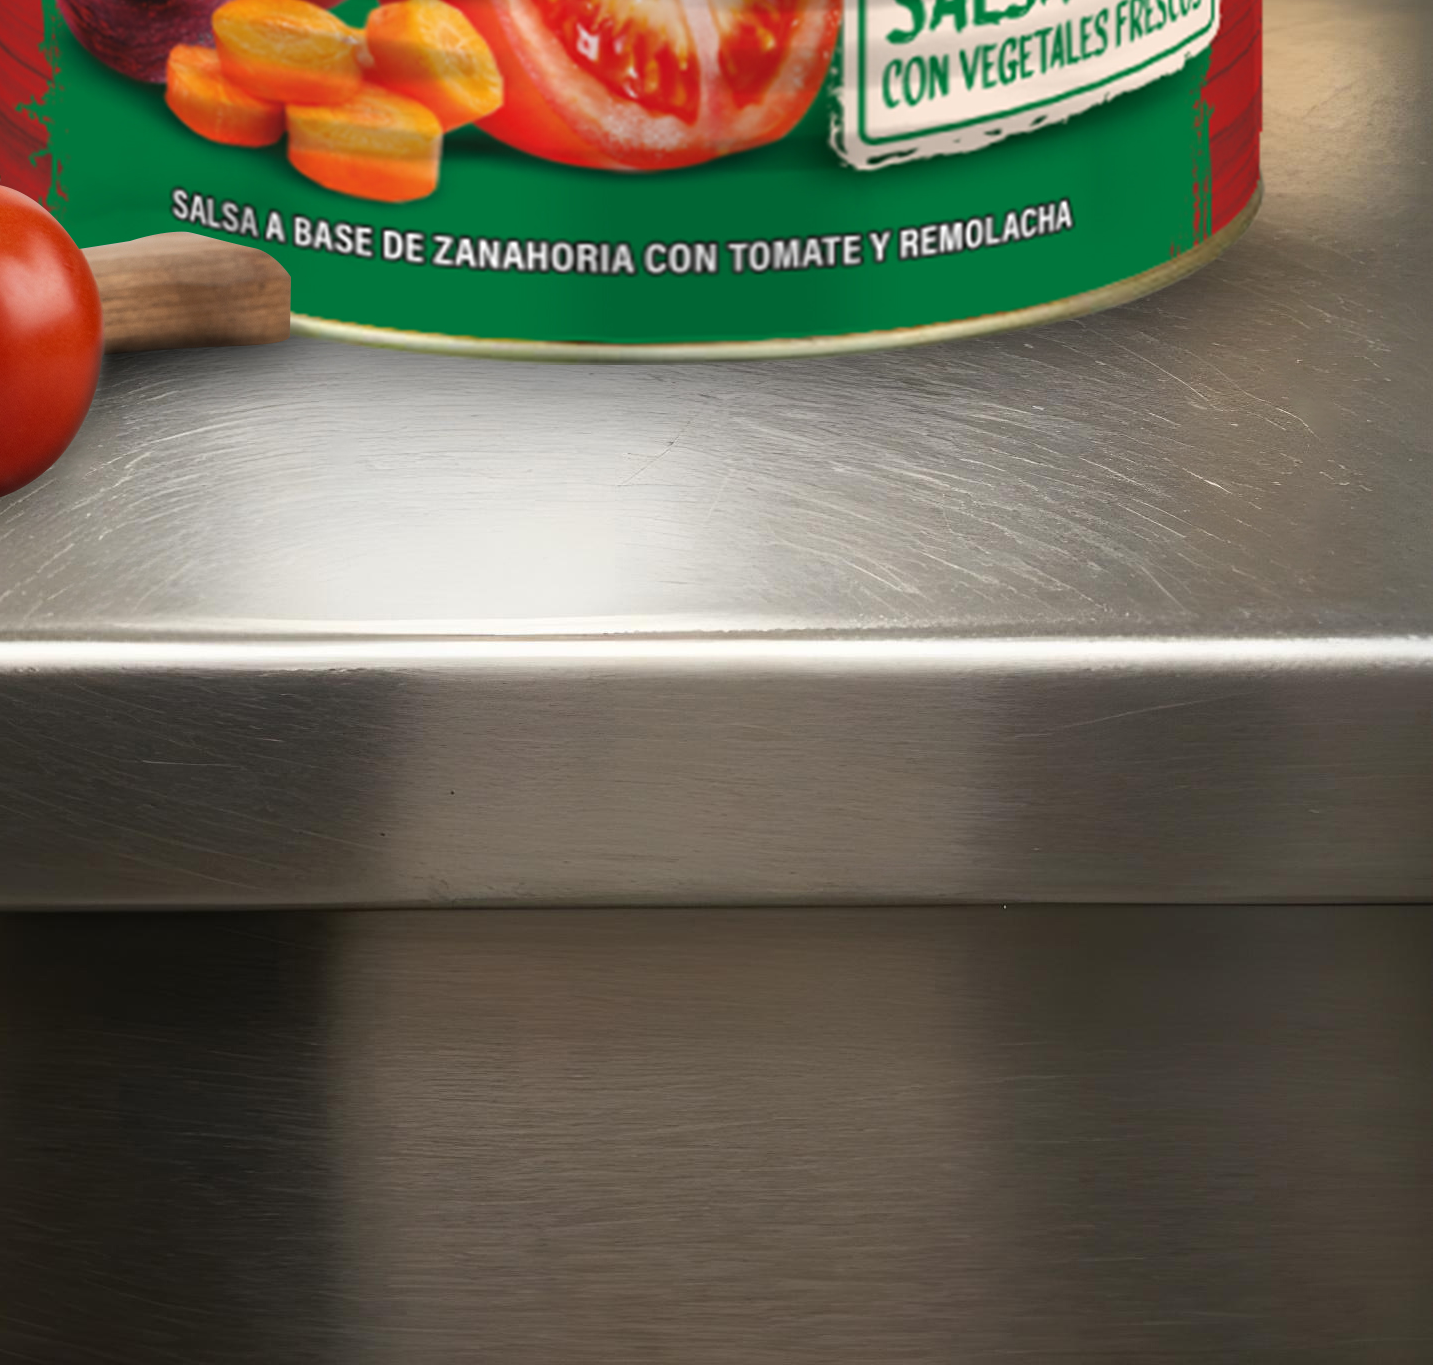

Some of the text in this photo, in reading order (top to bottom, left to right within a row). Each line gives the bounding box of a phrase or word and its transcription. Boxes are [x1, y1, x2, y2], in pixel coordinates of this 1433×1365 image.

[882, 53, 950, 109] CON
[959, 8, 1109, 91] VEGETALES
[172, 189, 1073, 275] SALSA A BASE DE ZANAHORIA CON TOMATE Y REMOLACHA
